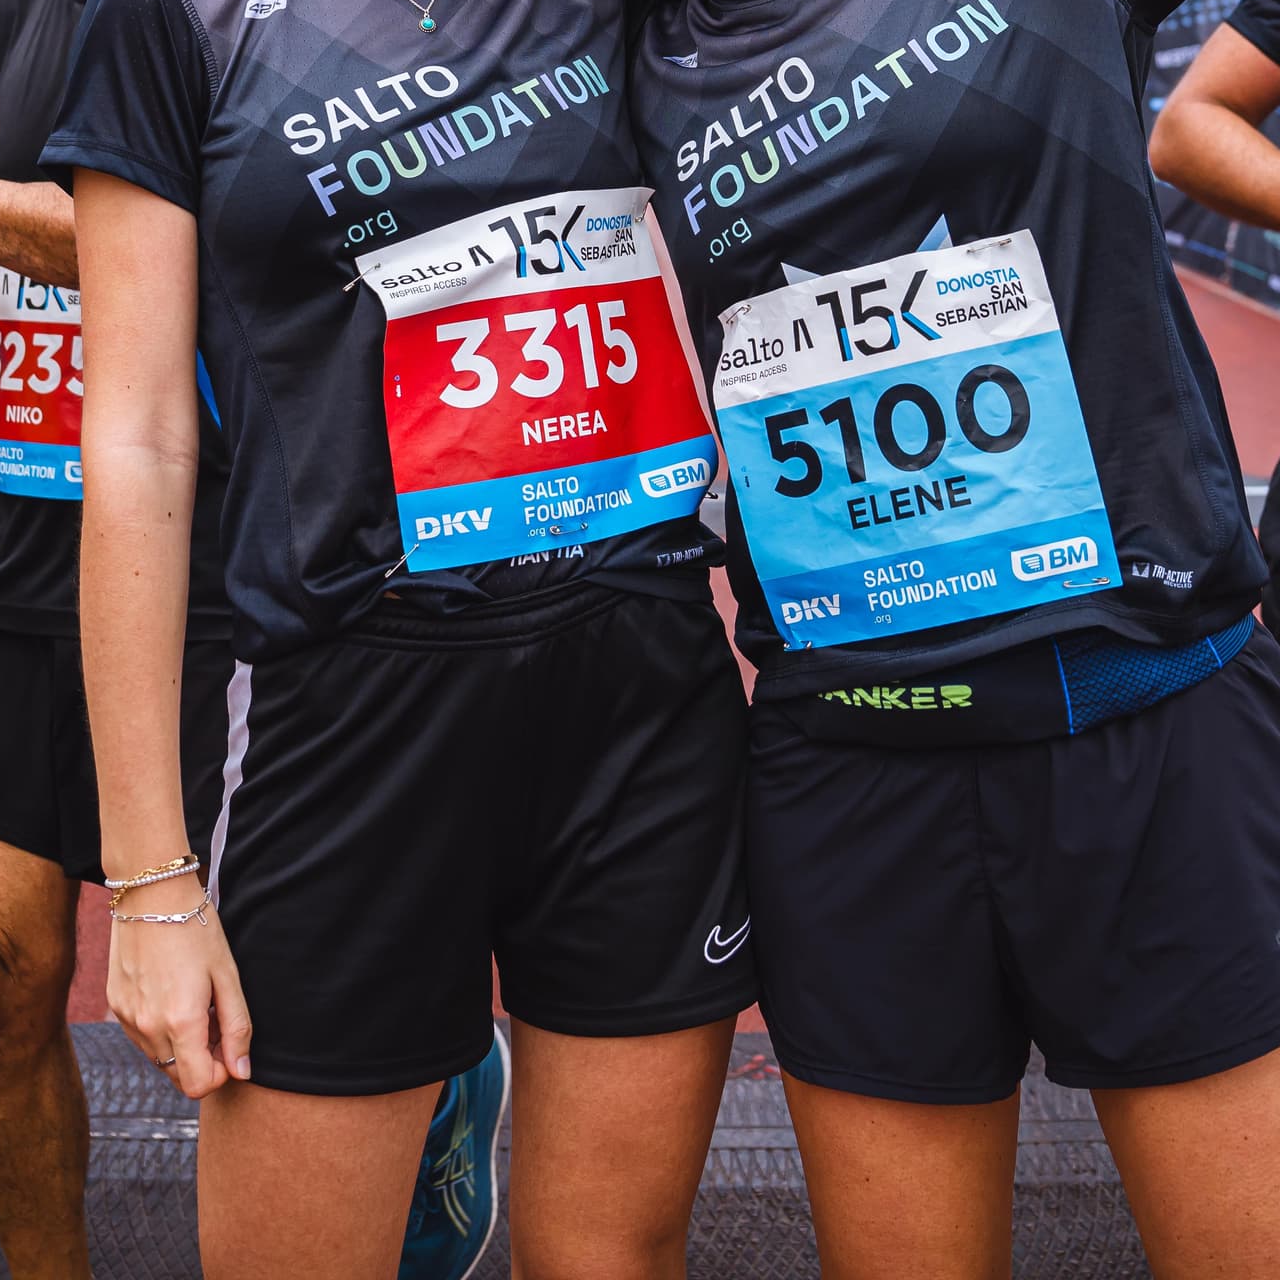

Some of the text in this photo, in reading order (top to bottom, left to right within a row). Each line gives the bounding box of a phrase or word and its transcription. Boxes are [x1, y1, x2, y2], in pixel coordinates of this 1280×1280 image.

[282, 64, 459, 157] SALTO
[675, 55, 815, 182] SALTO
[305, 53, 612, 219] FOUNDATION
[342, 207, 399, 249] .org
[586, 213, 633, 232] DONOSTIA
[614, 228, 634, 243] SAN
[579, 241, 637, 262] SEBASTIAN
[708, 217, 754, 264] .org
[380, 261, 463, 289] salto
[389, 276, 467, 300] INSPIRED ACCESS
[936, 266, 1021, 297] DONOSTIA
[990, 280, 1025, 301] SAN
[815, 268, 943, 362] 15K
[935, 295, 1029, 328] SEBASTIAN
[436, 299, 639, 409] 3315
[719, 336, 785, 372] salto
[720, 372, 758, 388] INSPIRED
[6, 404, 43, 426] NIKO
[521, 409, 608, 447] NEREA
[764, 362, 1032, 499] 5100
[522, 476, 579, 502] SALTO
[673, 464, 707, 486] BM
[523, 488, 633, 525] FOUNDATION
[847, 474, 973, 531] ELENE
[415, 506, 493, 542] DKV
[526, 524, 547, 538] .org
[1048, 542, 1090, 569] BM
[863, 560, 926, 588] SALTO
[1151, 564, 1195, 583] TRI-ACTIVE
[867, 568, 999, 612] FOUNDATION
[780, 593, 841, 625] DKV
[872, 613, 893, 625] .org
